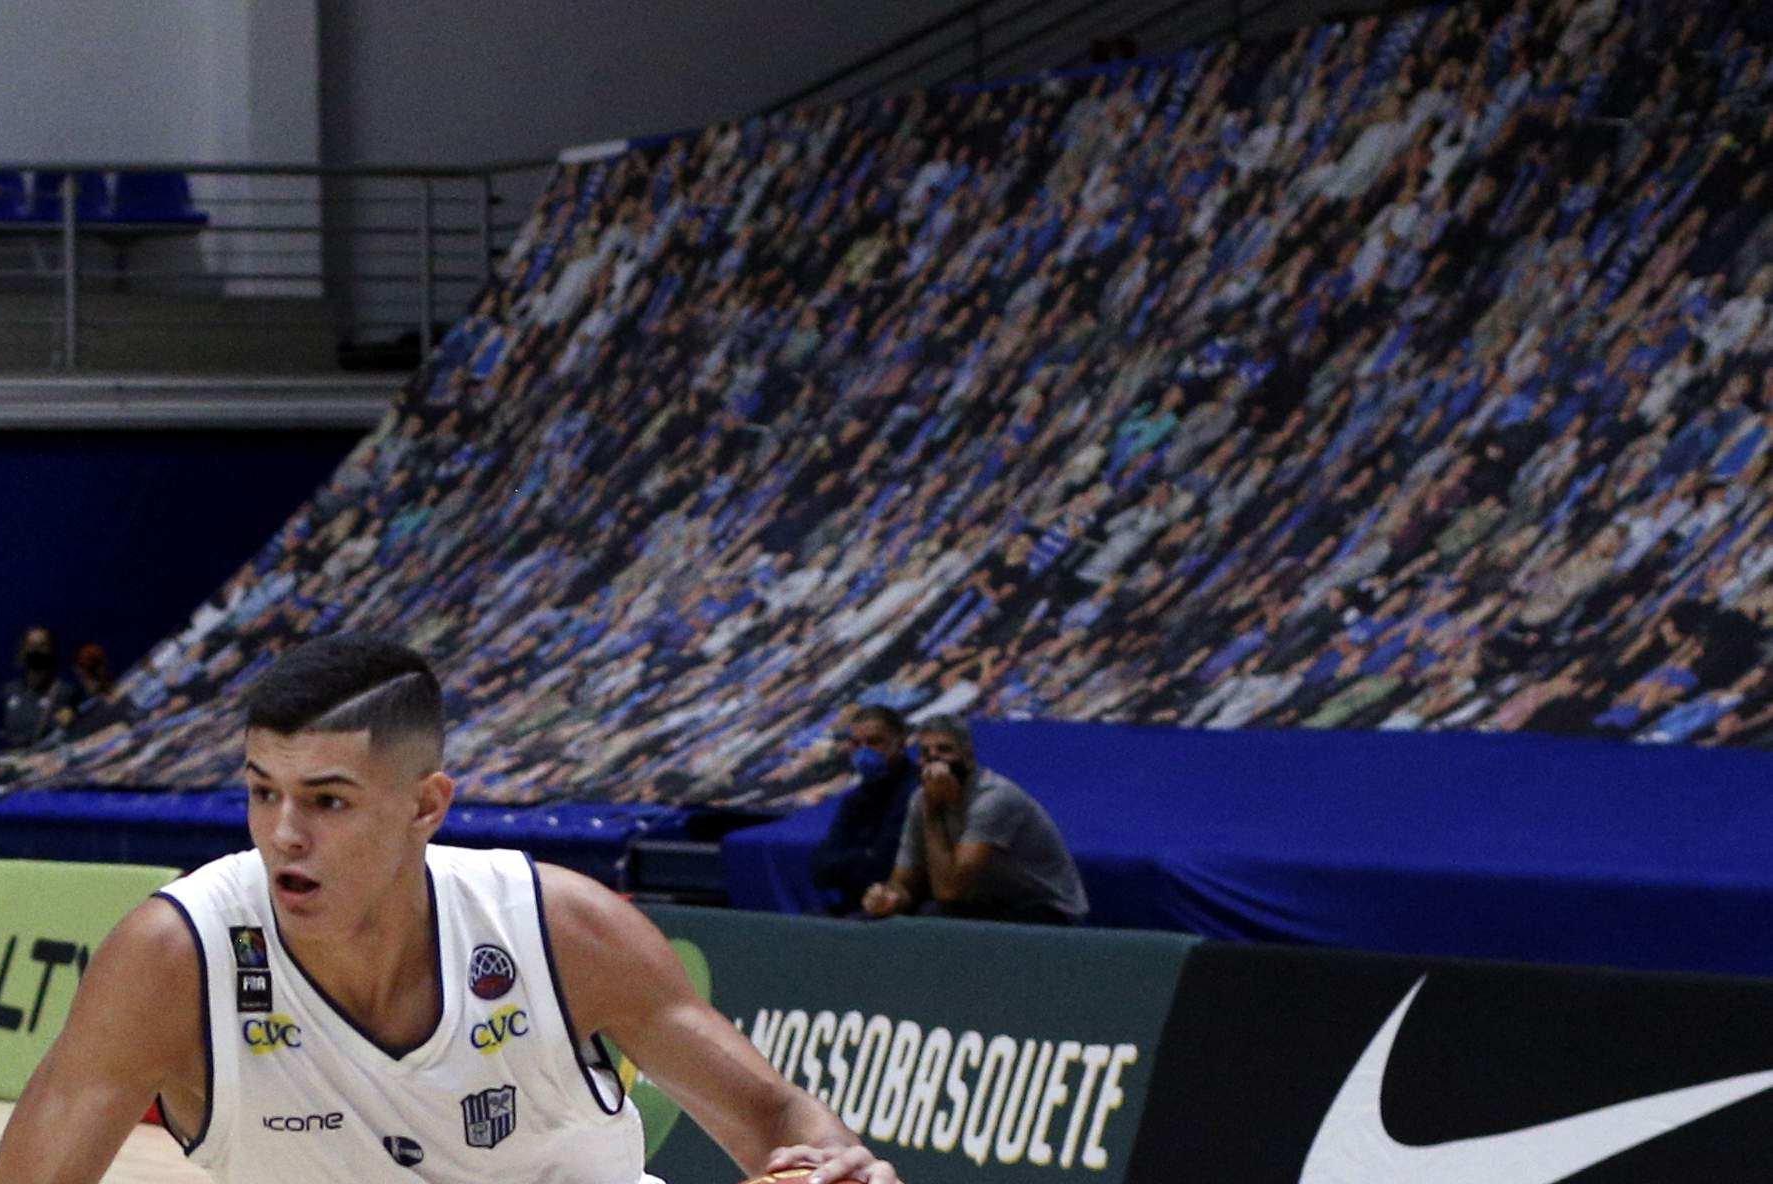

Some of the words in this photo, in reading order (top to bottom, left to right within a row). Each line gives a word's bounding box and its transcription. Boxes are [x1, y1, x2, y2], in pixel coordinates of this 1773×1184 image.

[242, 1019, 302, 1048] CVC
[470, 1010, 529, 1049] CVC
[734, 1008, 1138, 1170] NOSSOBASQUETE
